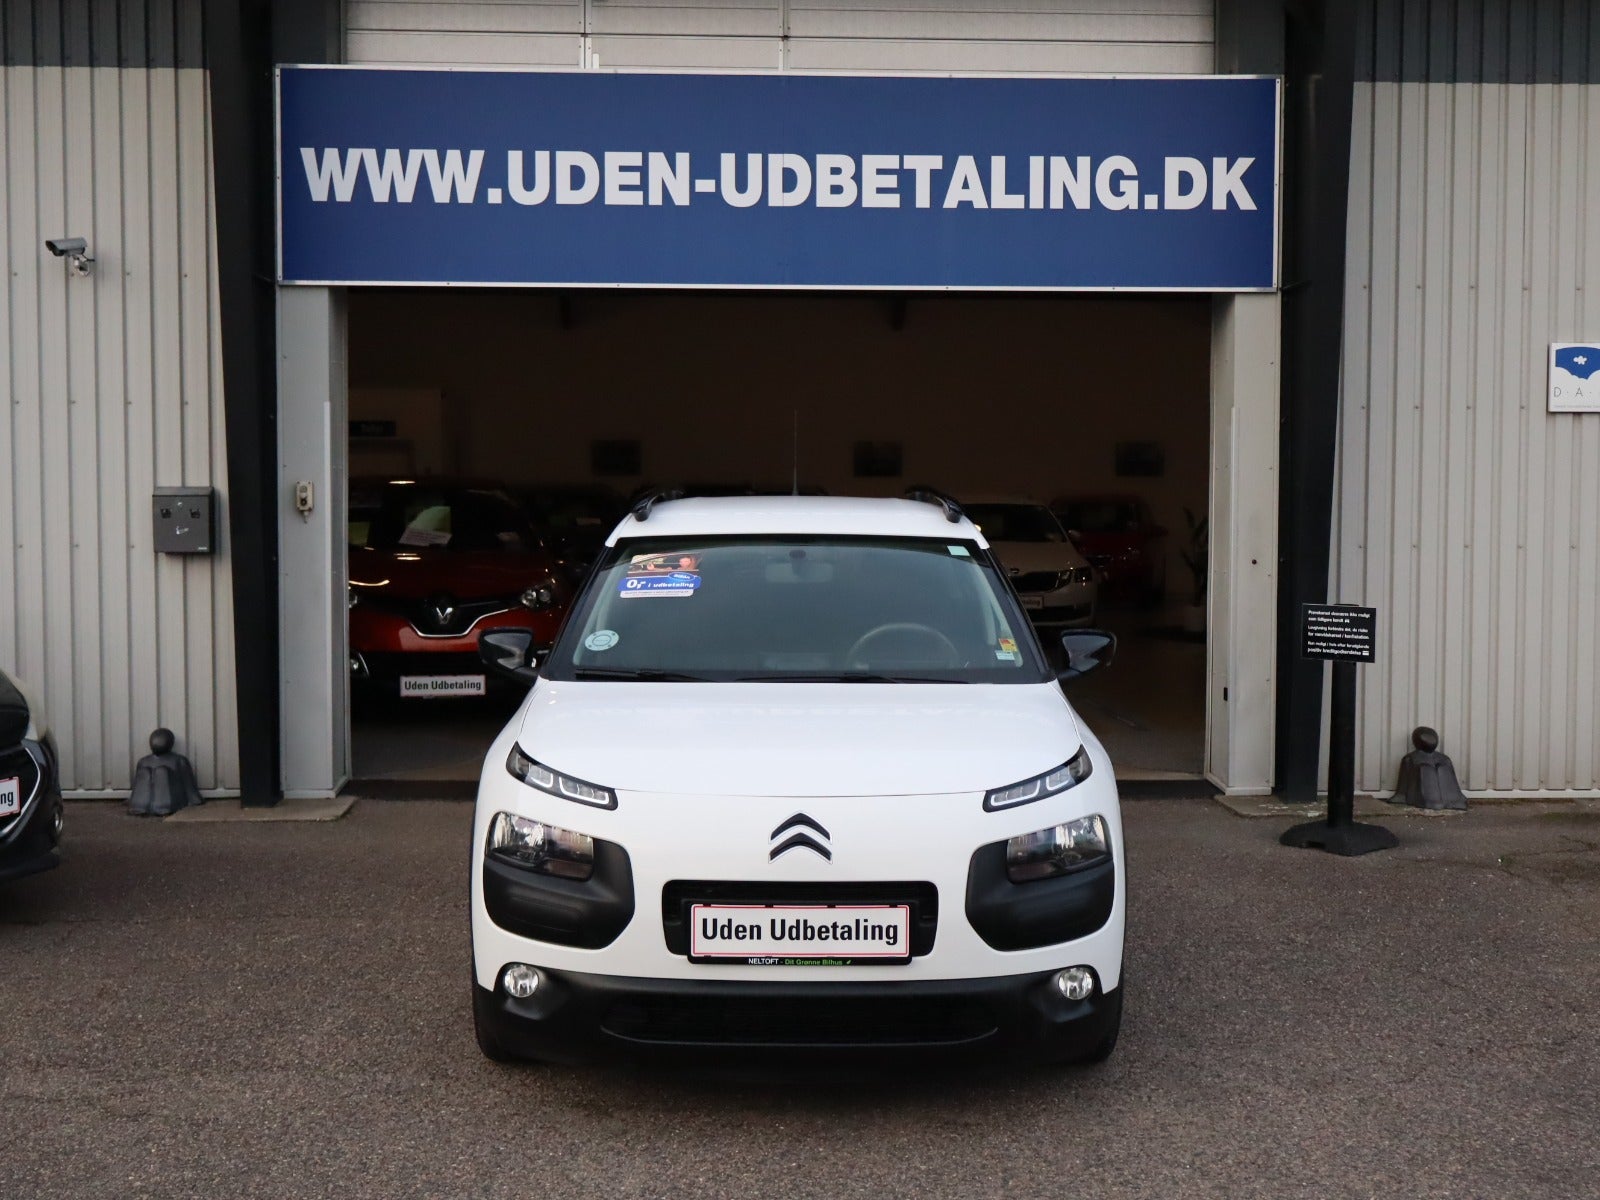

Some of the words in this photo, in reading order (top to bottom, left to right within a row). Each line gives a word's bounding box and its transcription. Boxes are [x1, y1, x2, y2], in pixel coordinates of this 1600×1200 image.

[300, 147, 1258, 212] WWW.UDEN-UDBETALING.DK
[404, 681, 429, 690] Uden
[431, 680, 481, 691] Udbetaling
[702, 917, 762, 941] Uden
[770, 917, 898, 946] Udbetaling
[822, 958, 843, 966] Bilhus
